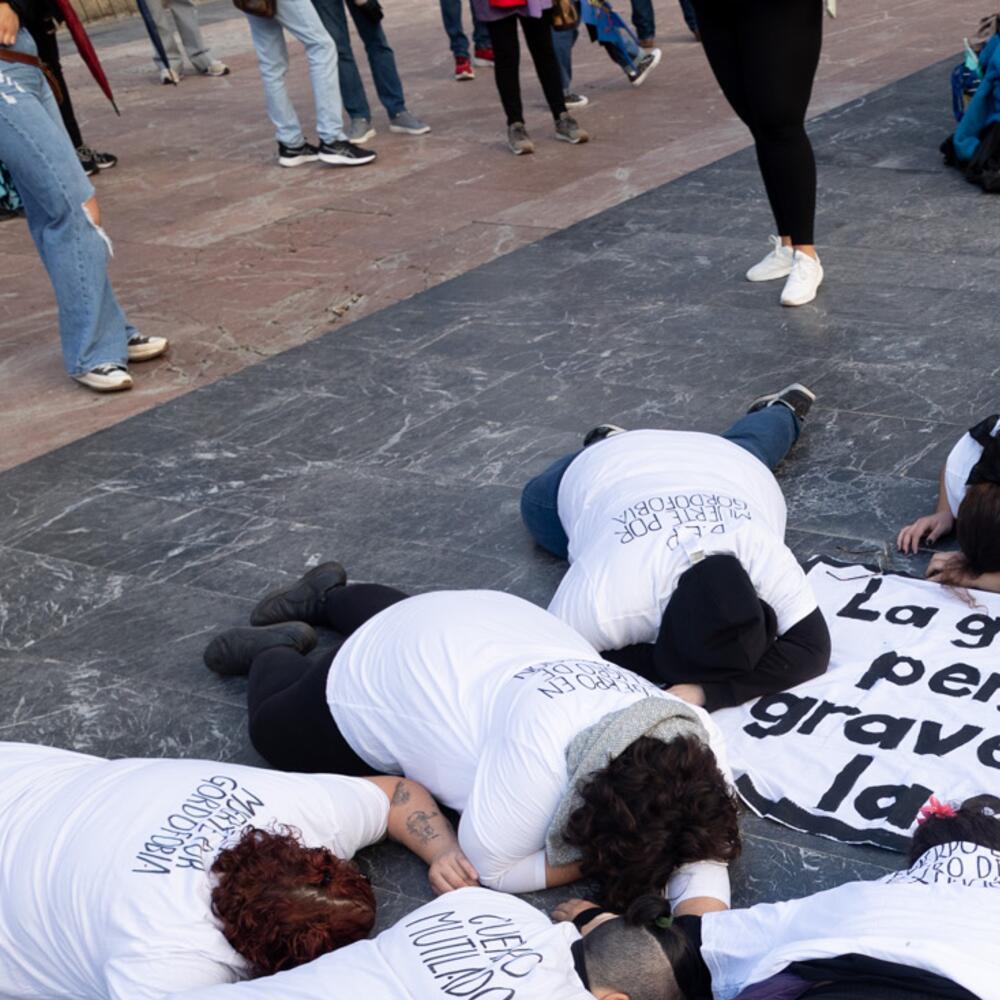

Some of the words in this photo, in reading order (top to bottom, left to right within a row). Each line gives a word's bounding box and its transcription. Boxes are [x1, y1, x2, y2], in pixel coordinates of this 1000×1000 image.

[612, 494, 748, 525] GORDOFOBIA
[614, 514, 662, 544] POR
[837, 578, 939, 627] La
[537, 675, 576, 699] EN
[817, 755, 932, 827] la
[131, 776, 238, 875] GORDOFOBIA
